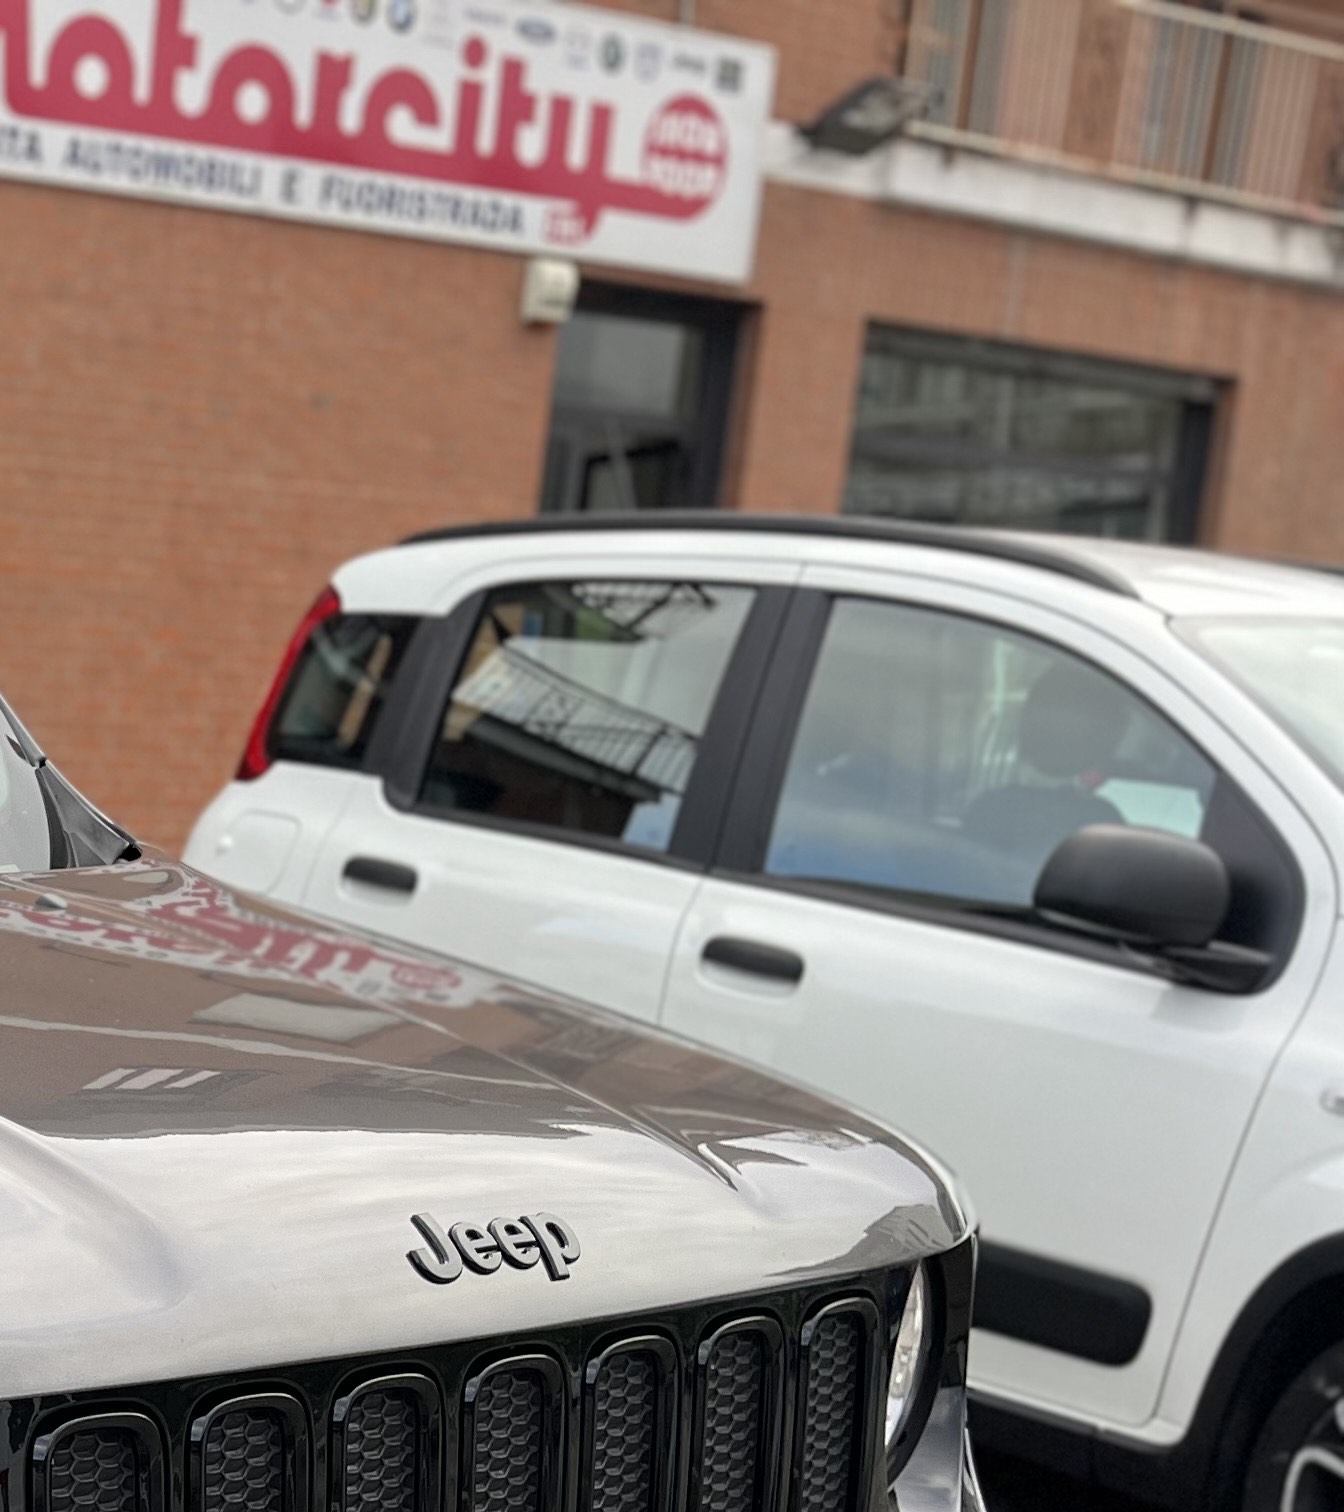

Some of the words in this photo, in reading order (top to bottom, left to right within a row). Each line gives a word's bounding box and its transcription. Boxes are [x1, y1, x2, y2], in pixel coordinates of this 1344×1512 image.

[63, 132, 263, 198] AUTOMOBILI
[280, 168, 304, 206] E
[319, 173, 526, 237] FUORISTRADA
[406, 1211, 582, 1283] Jeep
